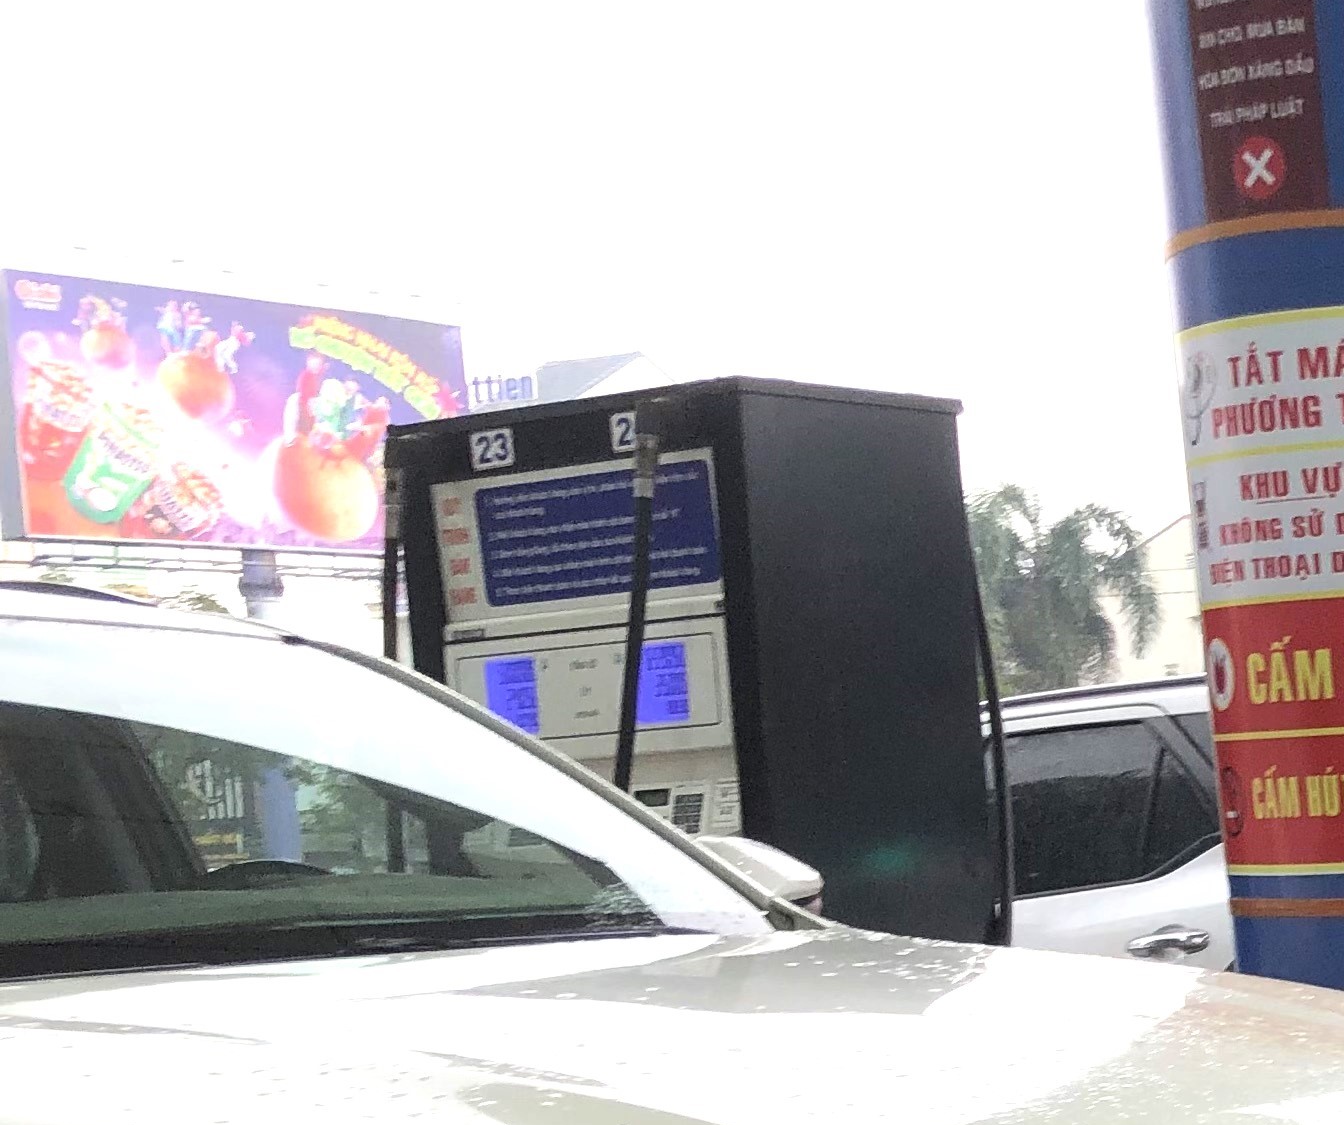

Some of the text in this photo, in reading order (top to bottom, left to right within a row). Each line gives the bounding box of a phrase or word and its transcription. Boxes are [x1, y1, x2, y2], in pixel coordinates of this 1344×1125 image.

[1227, 341, 1284, 389] TẮT
[616, 417, 636, 447] 2
[1211, 393, 1324, 440] PHƯƠNG
[475, 432, 509, 465] 23
[1239, 469, 1290, 501] KHU
[1219, 516, 1284, 546] KHÔNG
[1290, 507, 1325, 539] SỬ
[1251, 553, 1322, 581] THOẠI
[1246, 635, 1335, 705] CẤM
[1252, 764, 1301, 819] CẤM
